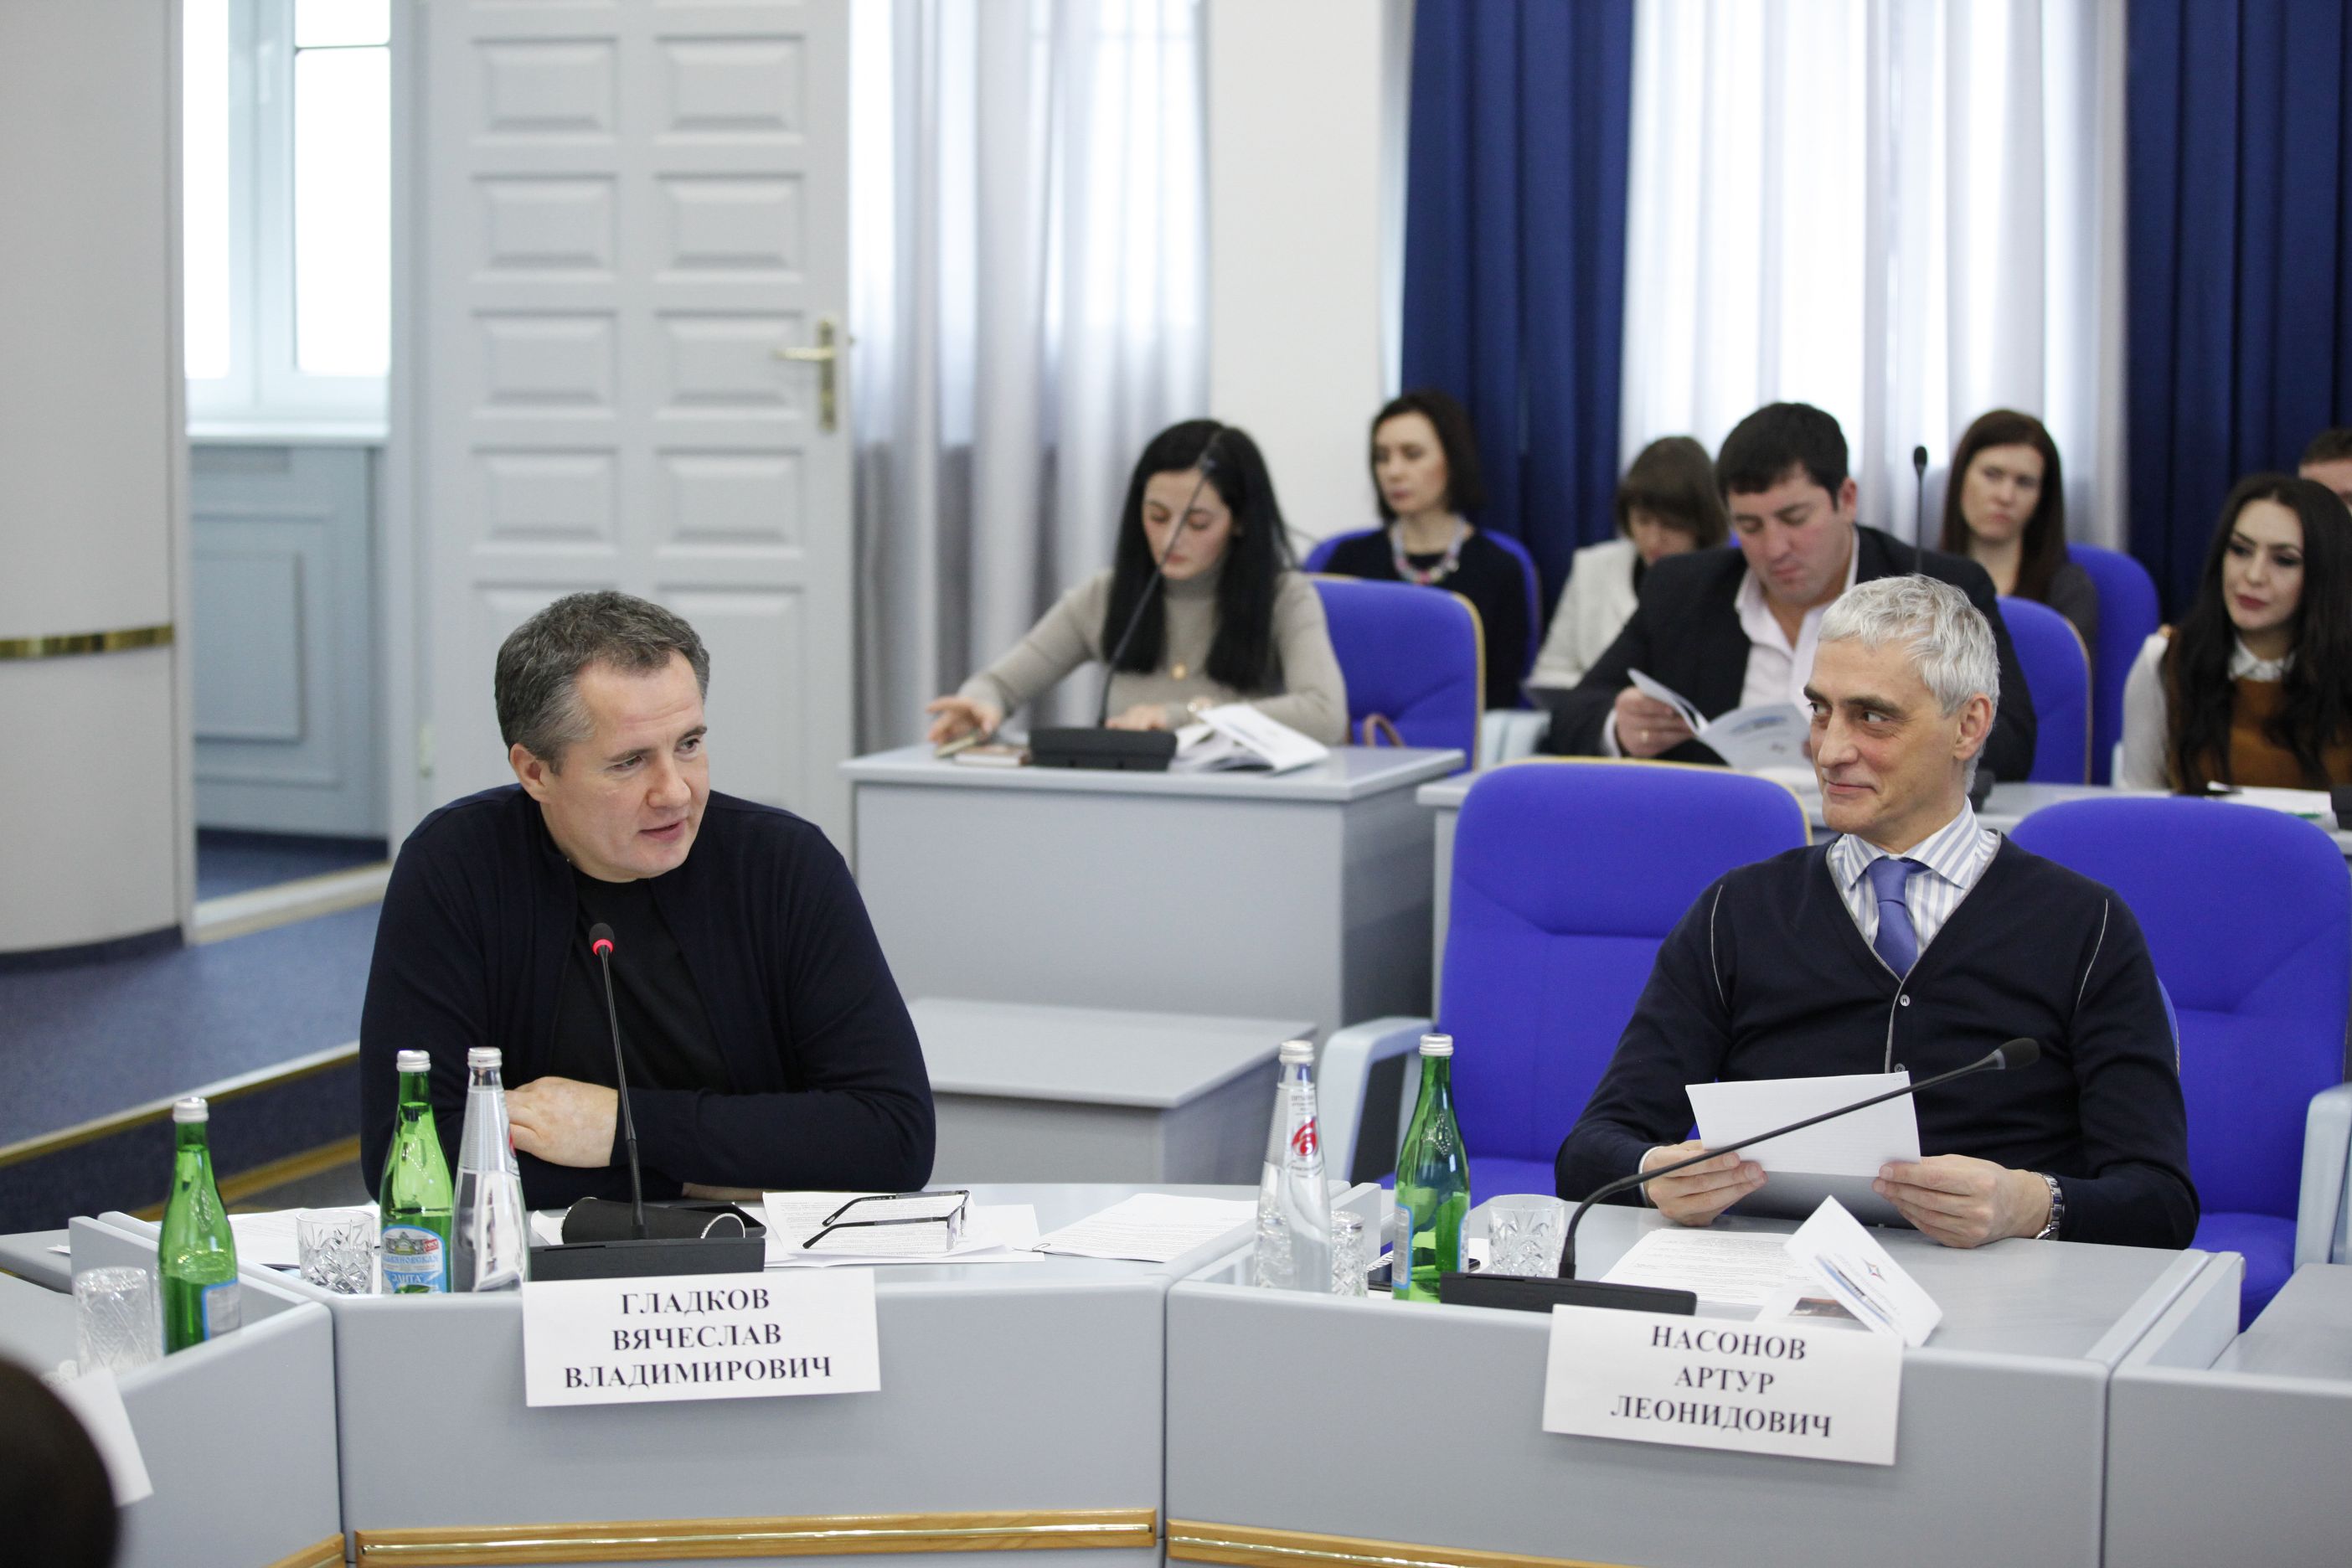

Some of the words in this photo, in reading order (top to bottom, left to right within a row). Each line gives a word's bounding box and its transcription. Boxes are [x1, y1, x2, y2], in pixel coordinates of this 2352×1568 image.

[622, 1288, 769, 1315] ГЛАДКОВ
[612, 1323, 781, 1351] ВЯЧЕСЛАВ
[1651, 1325, 1807, 1360] НАСОНОВ
[565, 1356, 832, 1390] ВЛАДИМИРОВИЧ
[1675, 1367, 1775, 1395] АРТУР
[1611, 1395, 1832, 1437] ЛЕОНИДОВИЧ
